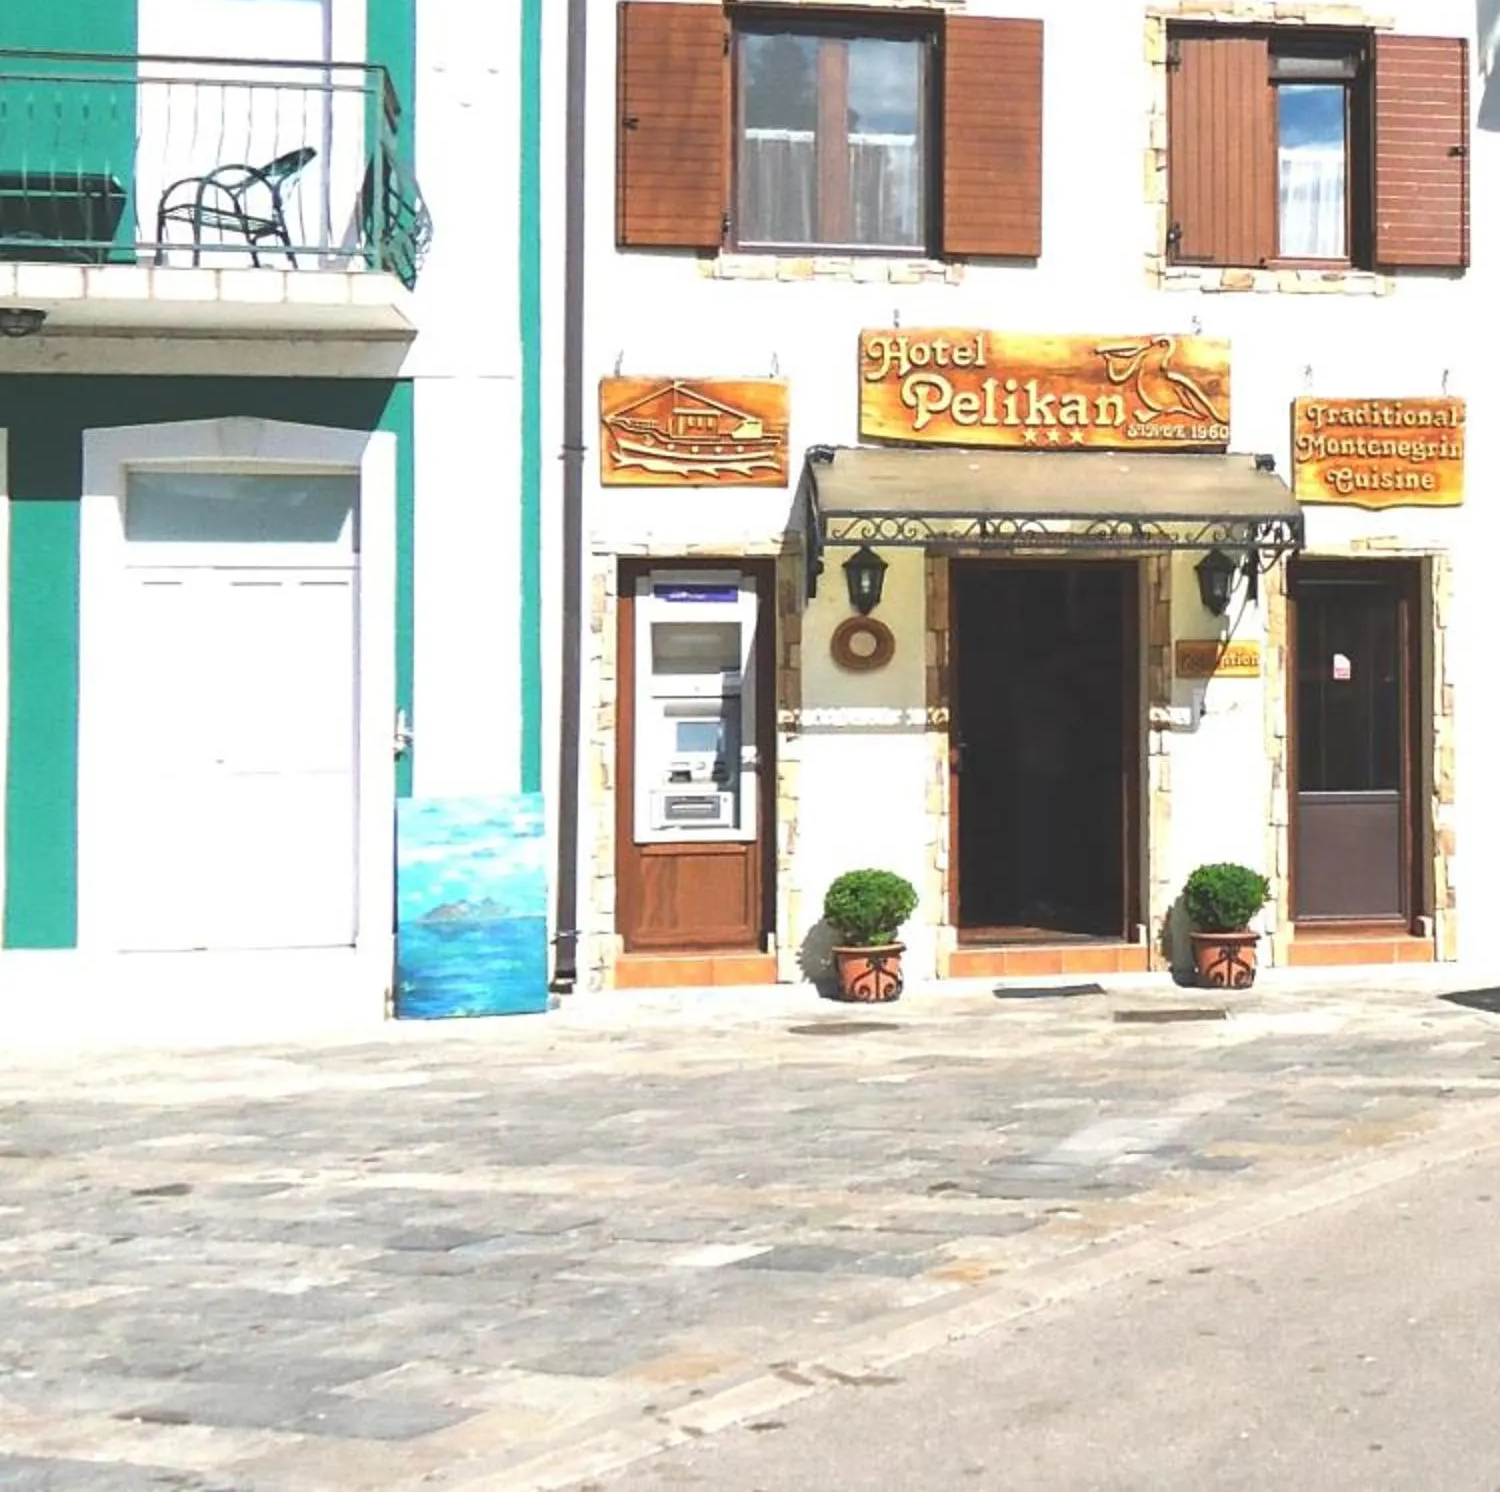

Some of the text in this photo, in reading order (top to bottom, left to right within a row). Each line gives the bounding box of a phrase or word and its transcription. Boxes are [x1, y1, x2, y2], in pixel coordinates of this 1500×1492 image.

[865, 334, 987, 384] Hotel
[901, 372, 1128, 429] Pelikan
[1306, 402, 1457, 428] Traditional
[1325, 465, 1436, 494] Cuisine
